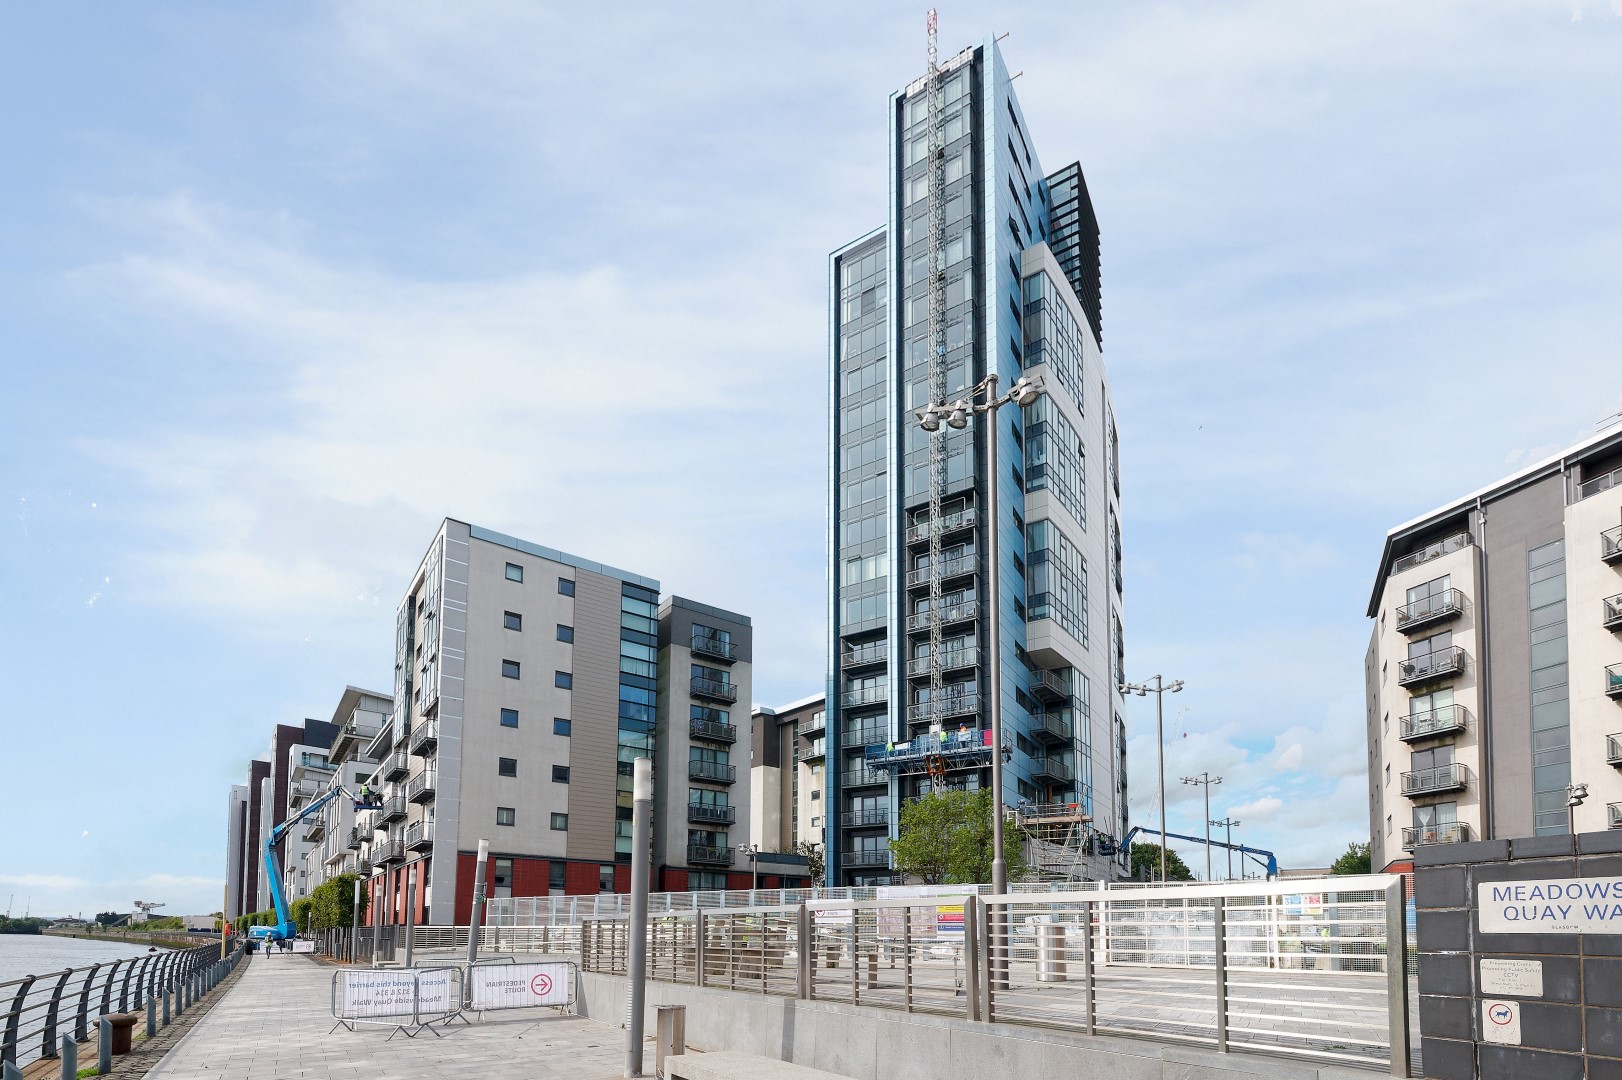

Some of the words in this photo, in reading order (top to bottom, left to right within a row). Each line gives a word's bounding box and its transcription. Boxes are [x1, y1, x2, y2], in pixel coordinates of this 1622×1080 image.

[1493, 882, 1622, 901] MEADOWS
[1503, 904, 1571, 920] QUAY
[1583, 903, 1622, 920] WA
